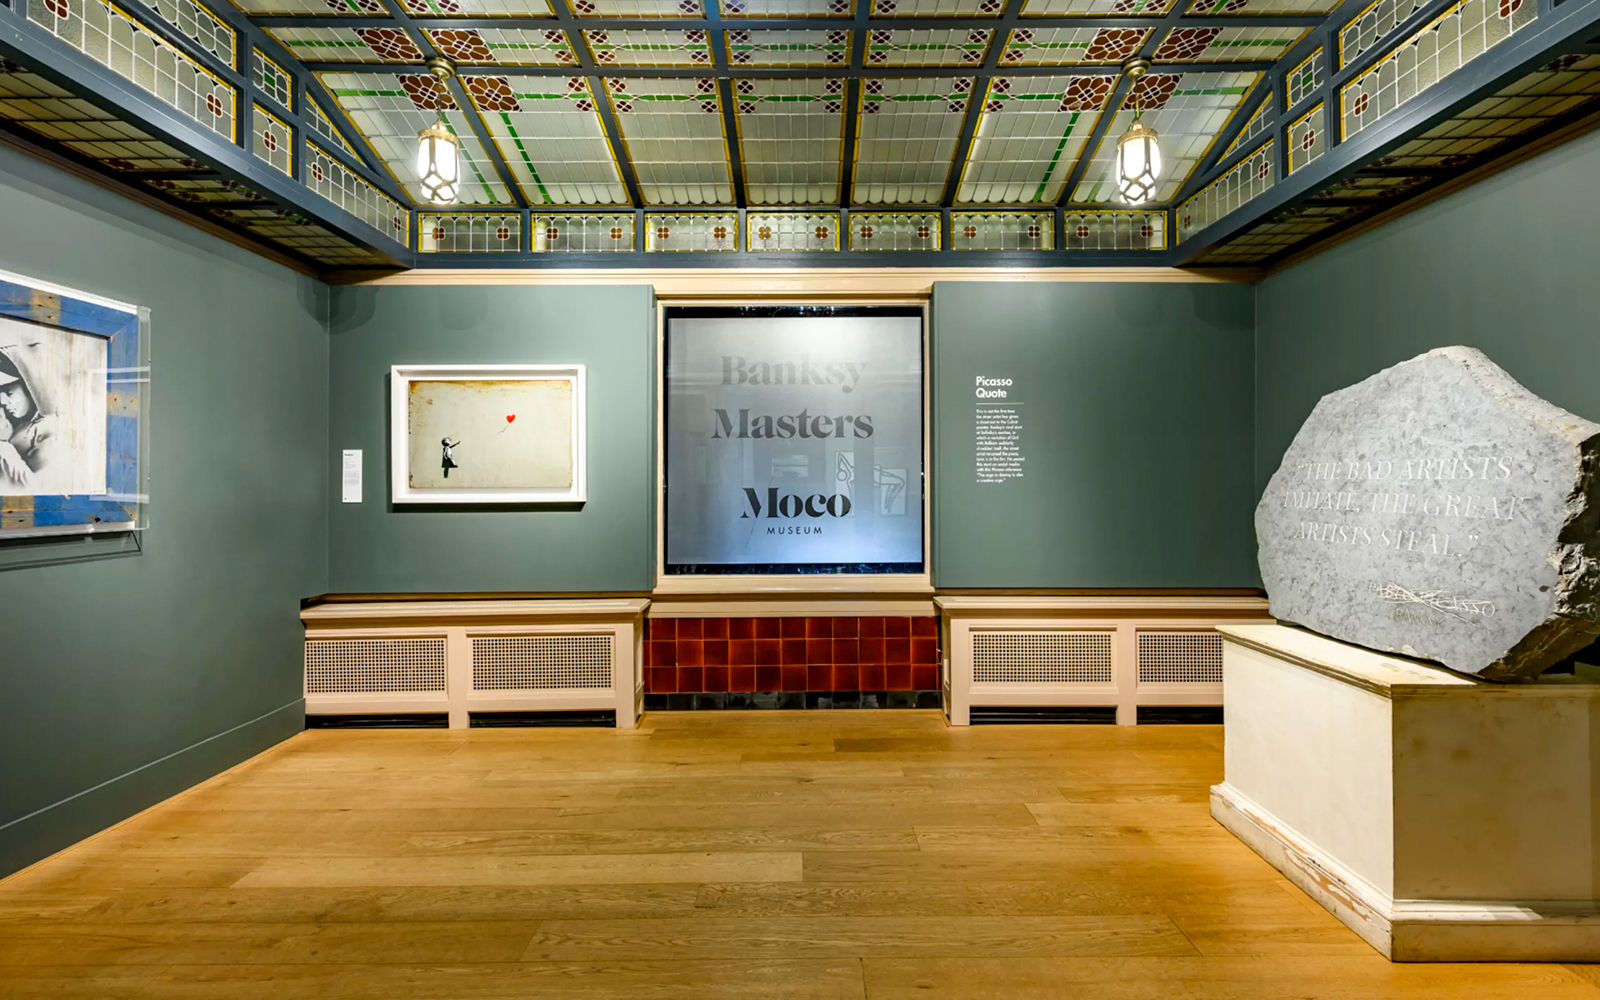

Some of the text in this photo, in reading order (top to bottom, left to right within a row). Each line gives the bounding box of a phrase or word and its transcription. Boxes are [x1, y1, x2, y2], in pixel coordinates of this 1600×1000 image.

[721, 353, 869, 394] Banksy
[976, 376, 1013, 386] Picasso
[976, 388, 1008, 398] Quote
[710, 407, 874, 440] Masters
[1347, 460, 1392, 480] BAD
[1398, 456, 1513, 481] ARTISTS
[740, 487, 852, 518] Moco
[1369, 492, 1416, 514] THE
[1423, 494, 1524, 520] GREAT
[766, 526, 822, 535] MUSEUM
[1293, 521, 1372, 546] ARTISTS
